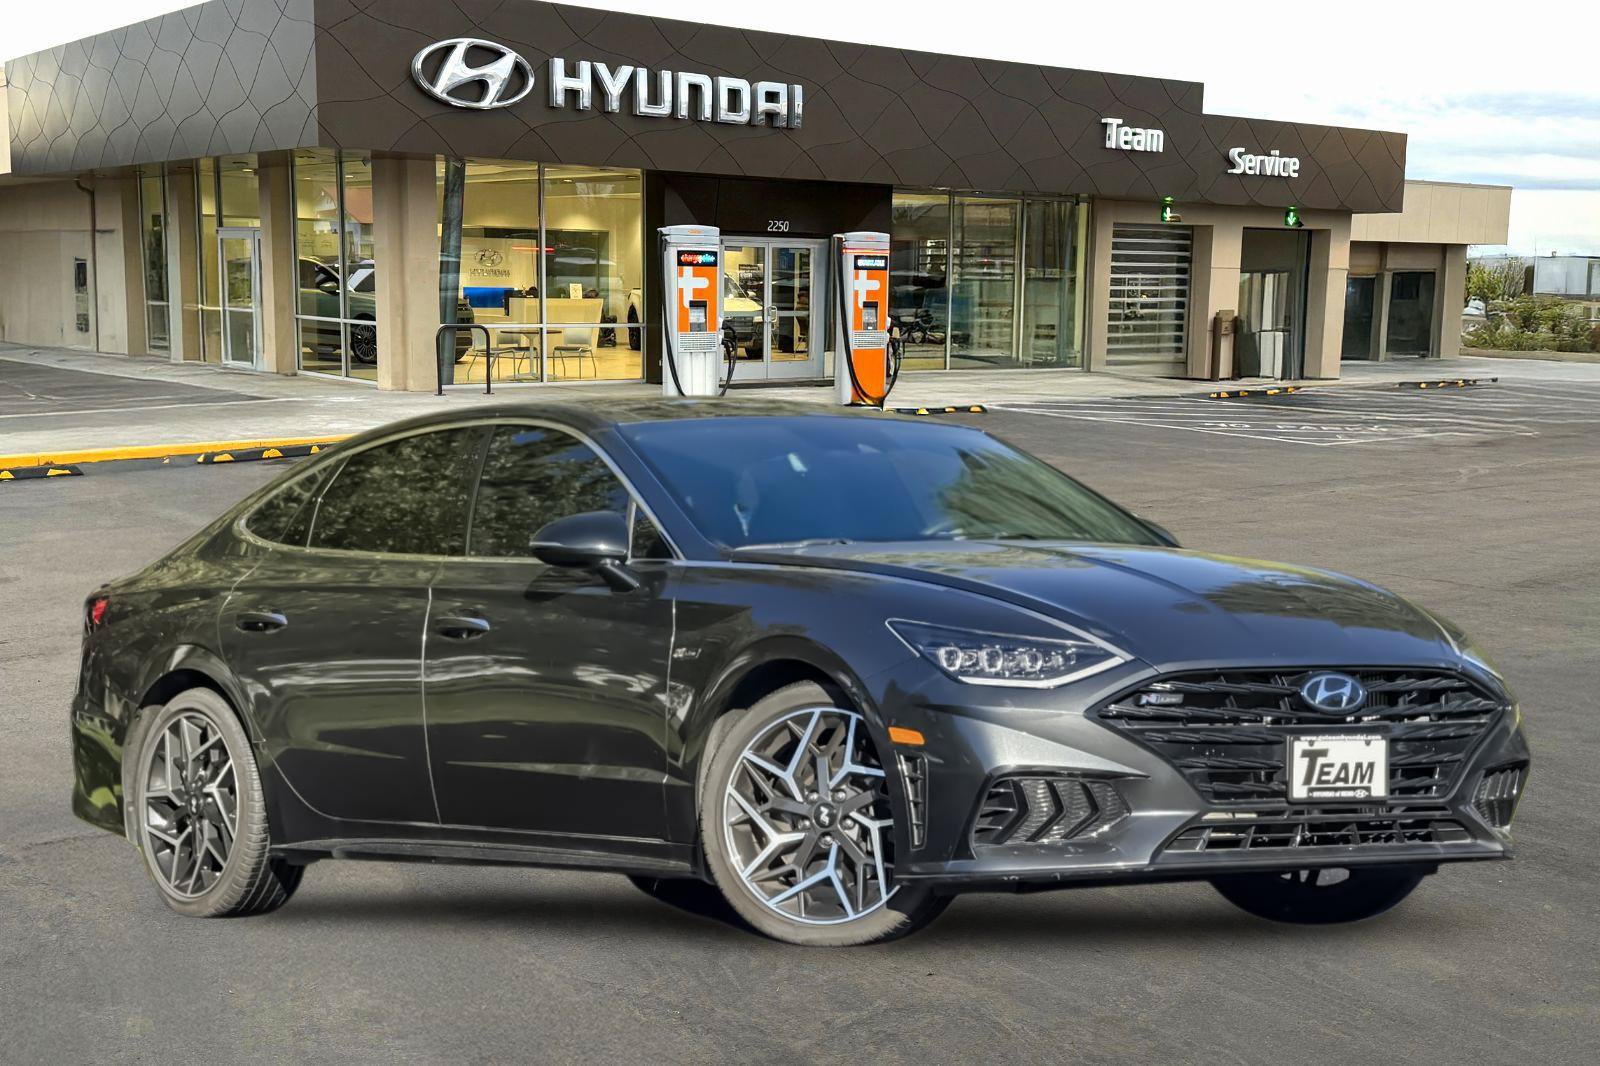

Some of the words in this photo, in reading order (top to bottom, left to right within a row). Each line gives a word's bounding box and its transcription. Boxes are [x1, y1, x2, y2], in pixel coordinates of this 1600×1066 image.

[549, 57, 803, 129] HYUNDAI
[1101, 117, 1165, 153] Team
[1227, 147, 1300, 178] Service
[767, 220, 790, 232] 2250
[1300, 748, 1376, 786] TEAM
